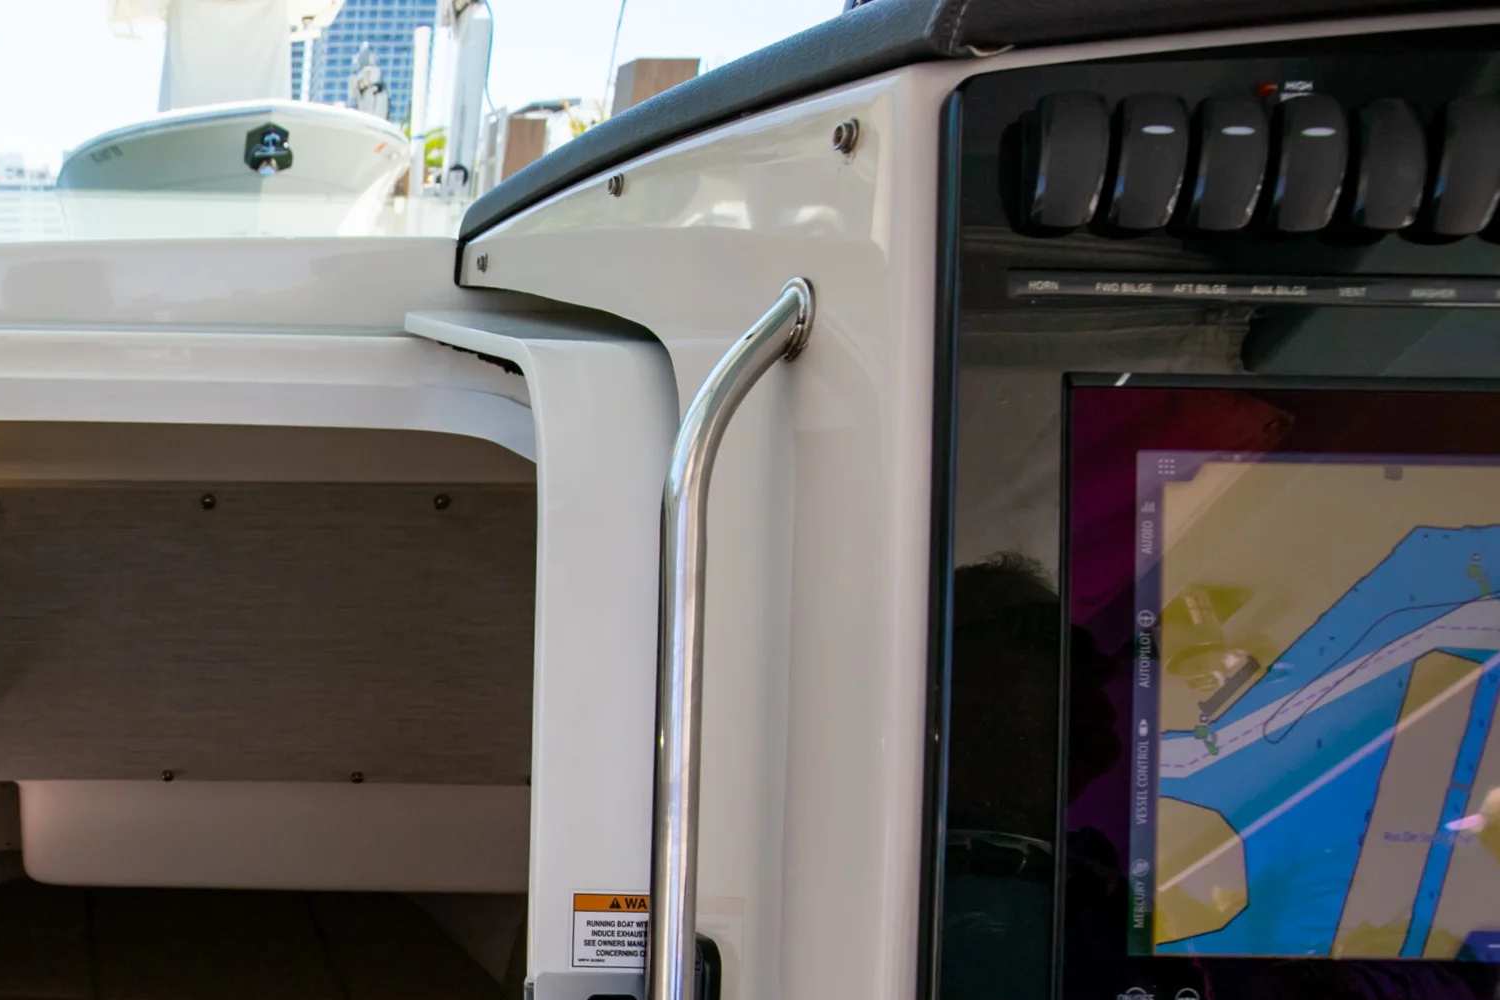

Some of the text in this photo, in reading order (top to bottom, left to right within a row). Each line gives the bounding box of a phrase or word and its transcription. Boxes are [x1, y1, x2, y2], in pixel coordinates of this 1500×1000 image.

[1028, 280, 1059, 290] HORN
[1095, 282, 1153, 293] FWD BILGE
[1172, 284, 1227, 294] AFT BILGE
[1250, 286, 1308, 296] AUX BILGE
[1338, 287, 1367, 297] VENT
[1141, 520, 1154, 554] AUDIO
[1139, 632, 1151, 688] AUTOPILOT
[1136, 740, 1149, 825] VESSEL CONTROL
[625, 897, 648, 909] WA
[1133, 880, 1146, 928] MERCURY
[586, 920, 616, 928] RUNNING
[617, 920, 634, 928] BOAT
[584, 939, 596, 947] SEE
